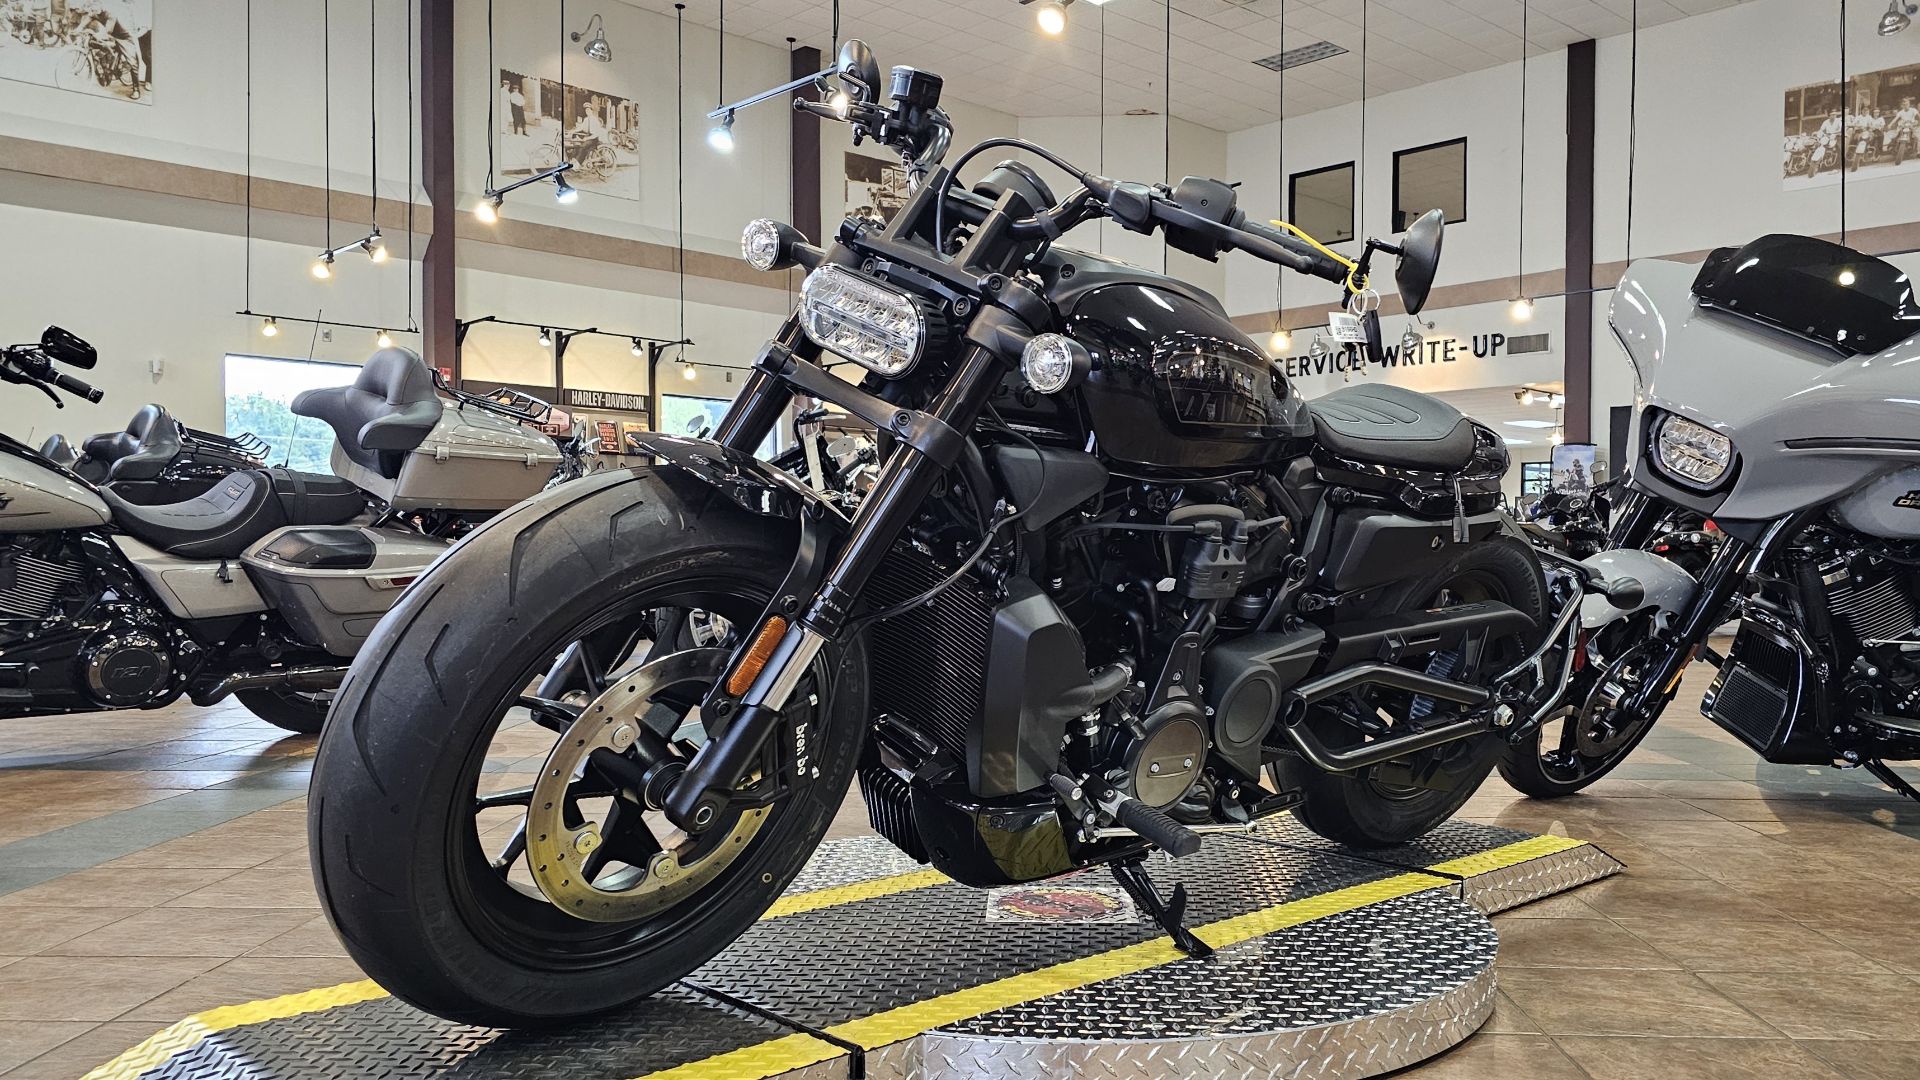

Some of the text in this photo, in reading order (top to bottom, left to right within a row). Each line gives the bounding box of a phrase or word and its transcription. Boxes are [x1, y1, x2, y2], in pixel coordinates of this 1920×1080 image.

[1274, 350, 1362, 377] ERVICE
[1381, 333, 1505, 368] WRITE-UP
[572, 390, 645, 410] HARLEY-DAVIDSON
